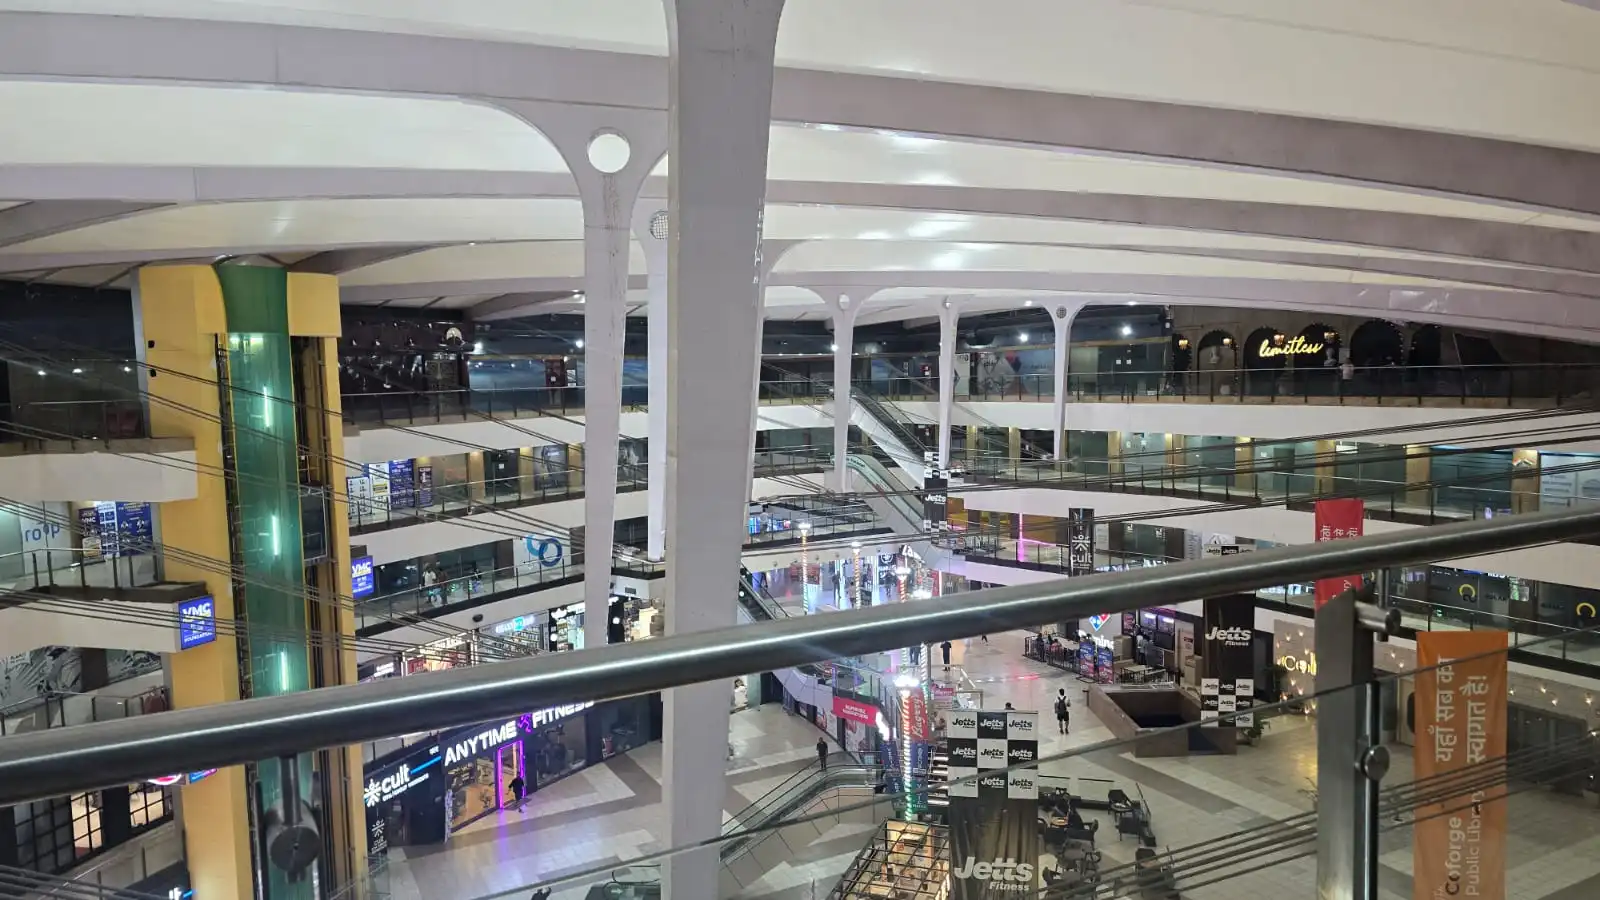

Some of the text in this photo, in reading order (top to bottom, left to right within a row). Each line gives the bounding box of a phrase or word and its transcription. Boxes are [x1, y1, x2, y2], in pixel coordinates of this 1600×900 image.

[1259, 335, 1323, 357] limitless
[25, 524, 60, 542] rop
[1071, 552, 1092, 563] cult
[182, 602, 212, 617] VMC
[1205, 626, 1252, 641] Jetts
[1435, 688, 1455, 722] सब
[952, 718, 976, 726] Jetts
[980, 719, 1005, 727] Jetts
[1009, 719, 1033, 728] Jetts
[1466, 700, 1487, 764] स्वागत
[444, 720, 517, 767] ANYTIME
[952, 747, 977, 755] Jetts
[1427, 724, 1457, 763] यहाँ
[980, 748, 1005, 756] Jetts
[1008, 749, 1033, 757] Jetts
[381, 764, 410, 793] cult
[980, 777, 1005, 786] Jetts
[1009, 777, 1033, 787] Jetts
[1445, 817, 1465, 895] Coforge
[954, 856, 1034, 882] Jetts
[1465, 846, 1479, 896] Public
[989, 881, 1030, 891] Fitness
